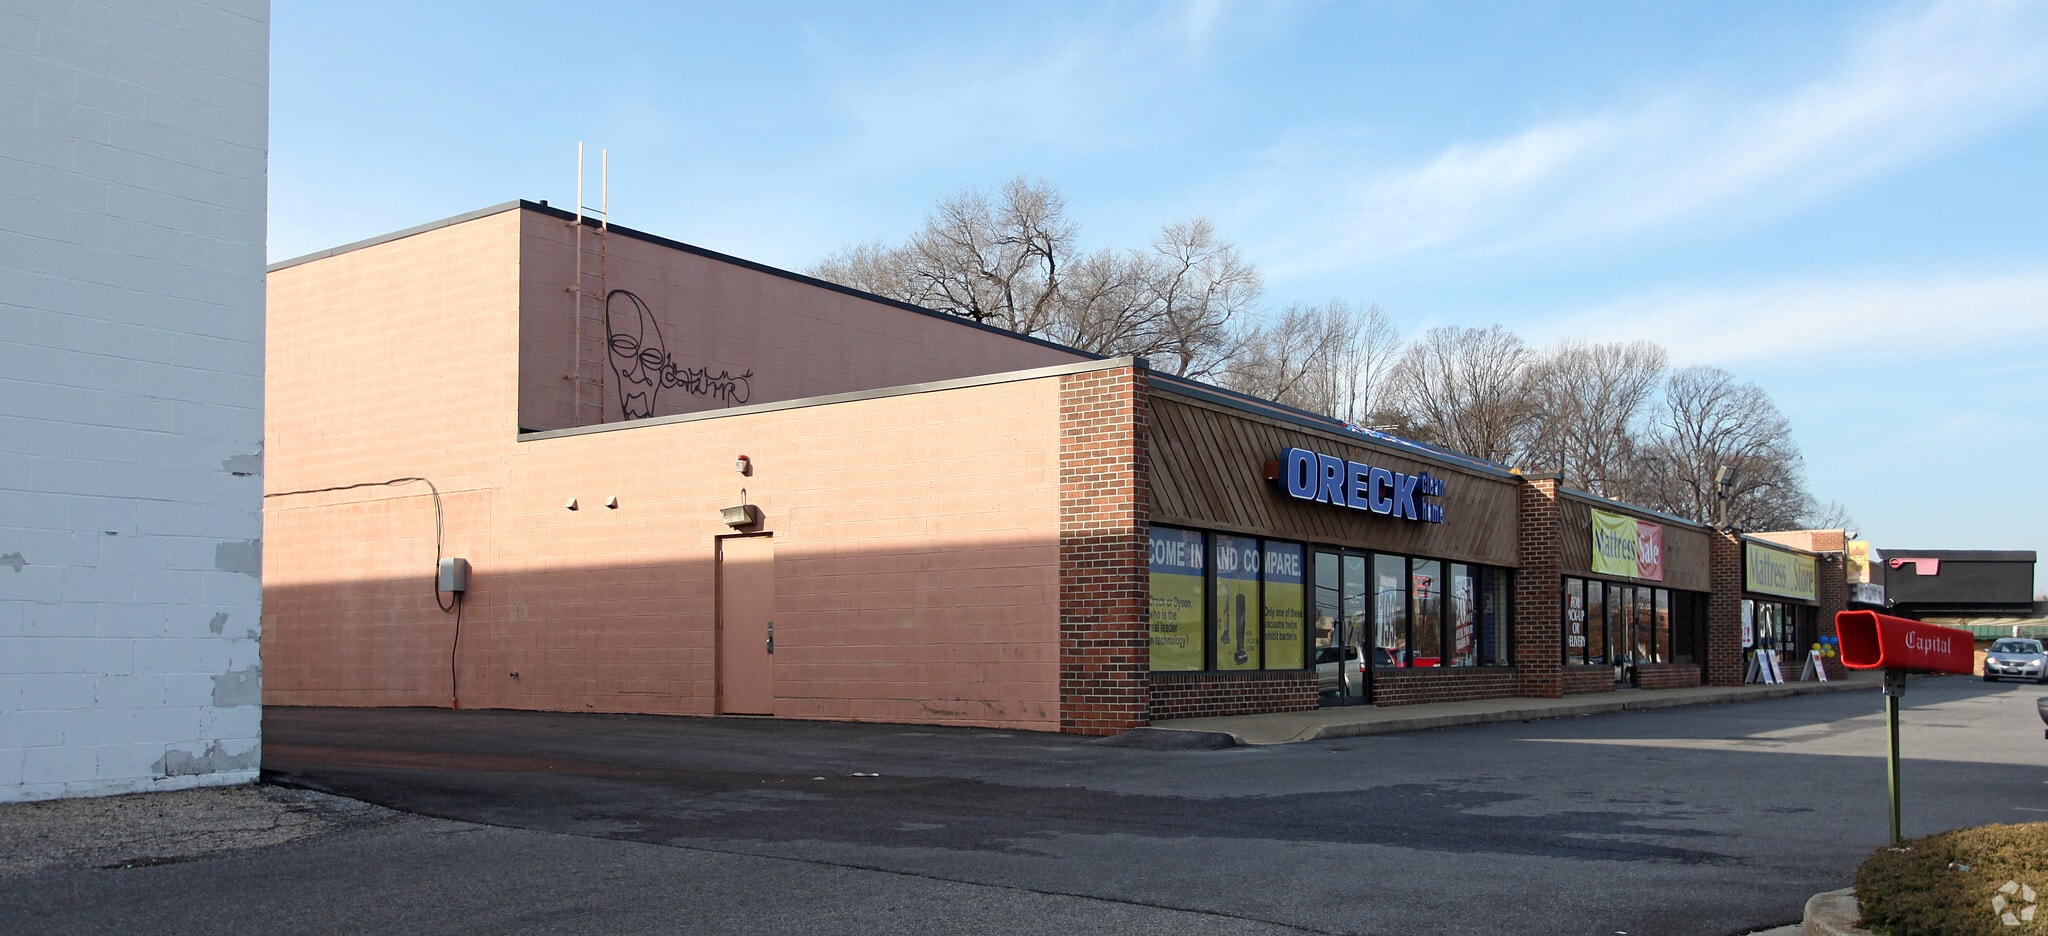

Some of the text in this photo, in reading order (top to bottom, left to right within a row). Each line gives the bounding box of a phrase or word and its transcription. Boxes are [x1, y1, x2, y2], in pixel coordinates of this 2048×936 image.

[1287, 447, 1418, 521] ORECK
[1422, 471, 1445, 497] clean
[1149, 538, 1185, 567] COME
[1190, 542, 1204, 568] IN
[1595, 526, 1659, 565] Mattress Sale
[1750, 546, 1814, 594] Mattress Store
[1570, 596, 1581, 609] FOR
[1265, 630, 1279, 641] nhibit
[1572, 622, 1580, 634] OR
[1568, 635, 1586, 648] ELIVERY
[1905, 630, 1952, 656] Capital
